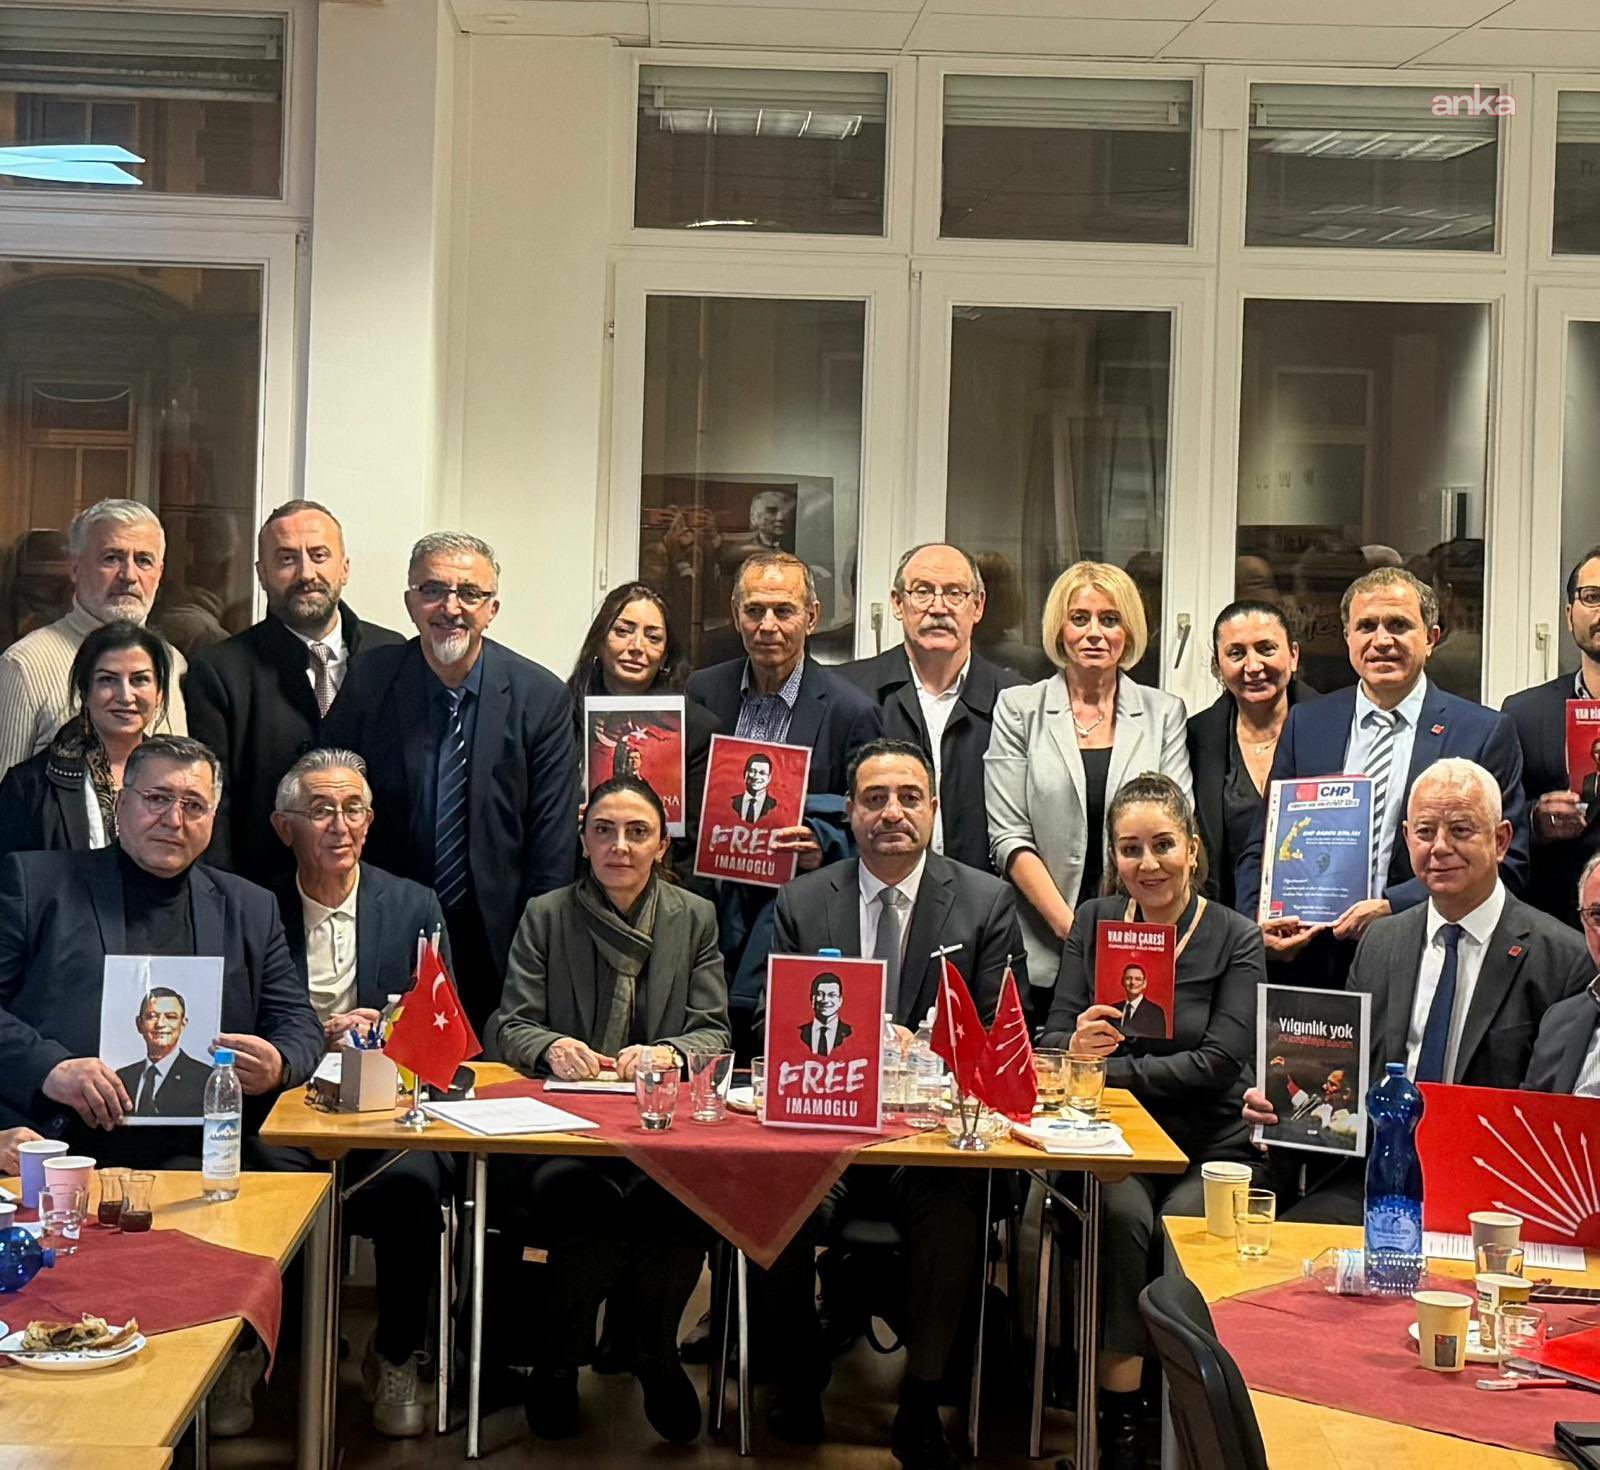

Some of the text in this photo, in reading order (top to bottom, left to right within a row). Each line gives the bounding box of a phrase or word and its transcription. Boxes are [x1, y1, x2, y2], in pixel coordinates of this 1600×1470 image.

[1320, 786, 1351, 797] CHP
[1108, 931, 1123, 943] VAR
[1124, 930, 1137, 944] BİR
[1279, 1017, 1354, 1040] Yılgınlık yok
[778, 1058, 868, 1095] FREE
[785, 1097, 858, 1117] IMAMOGLU
